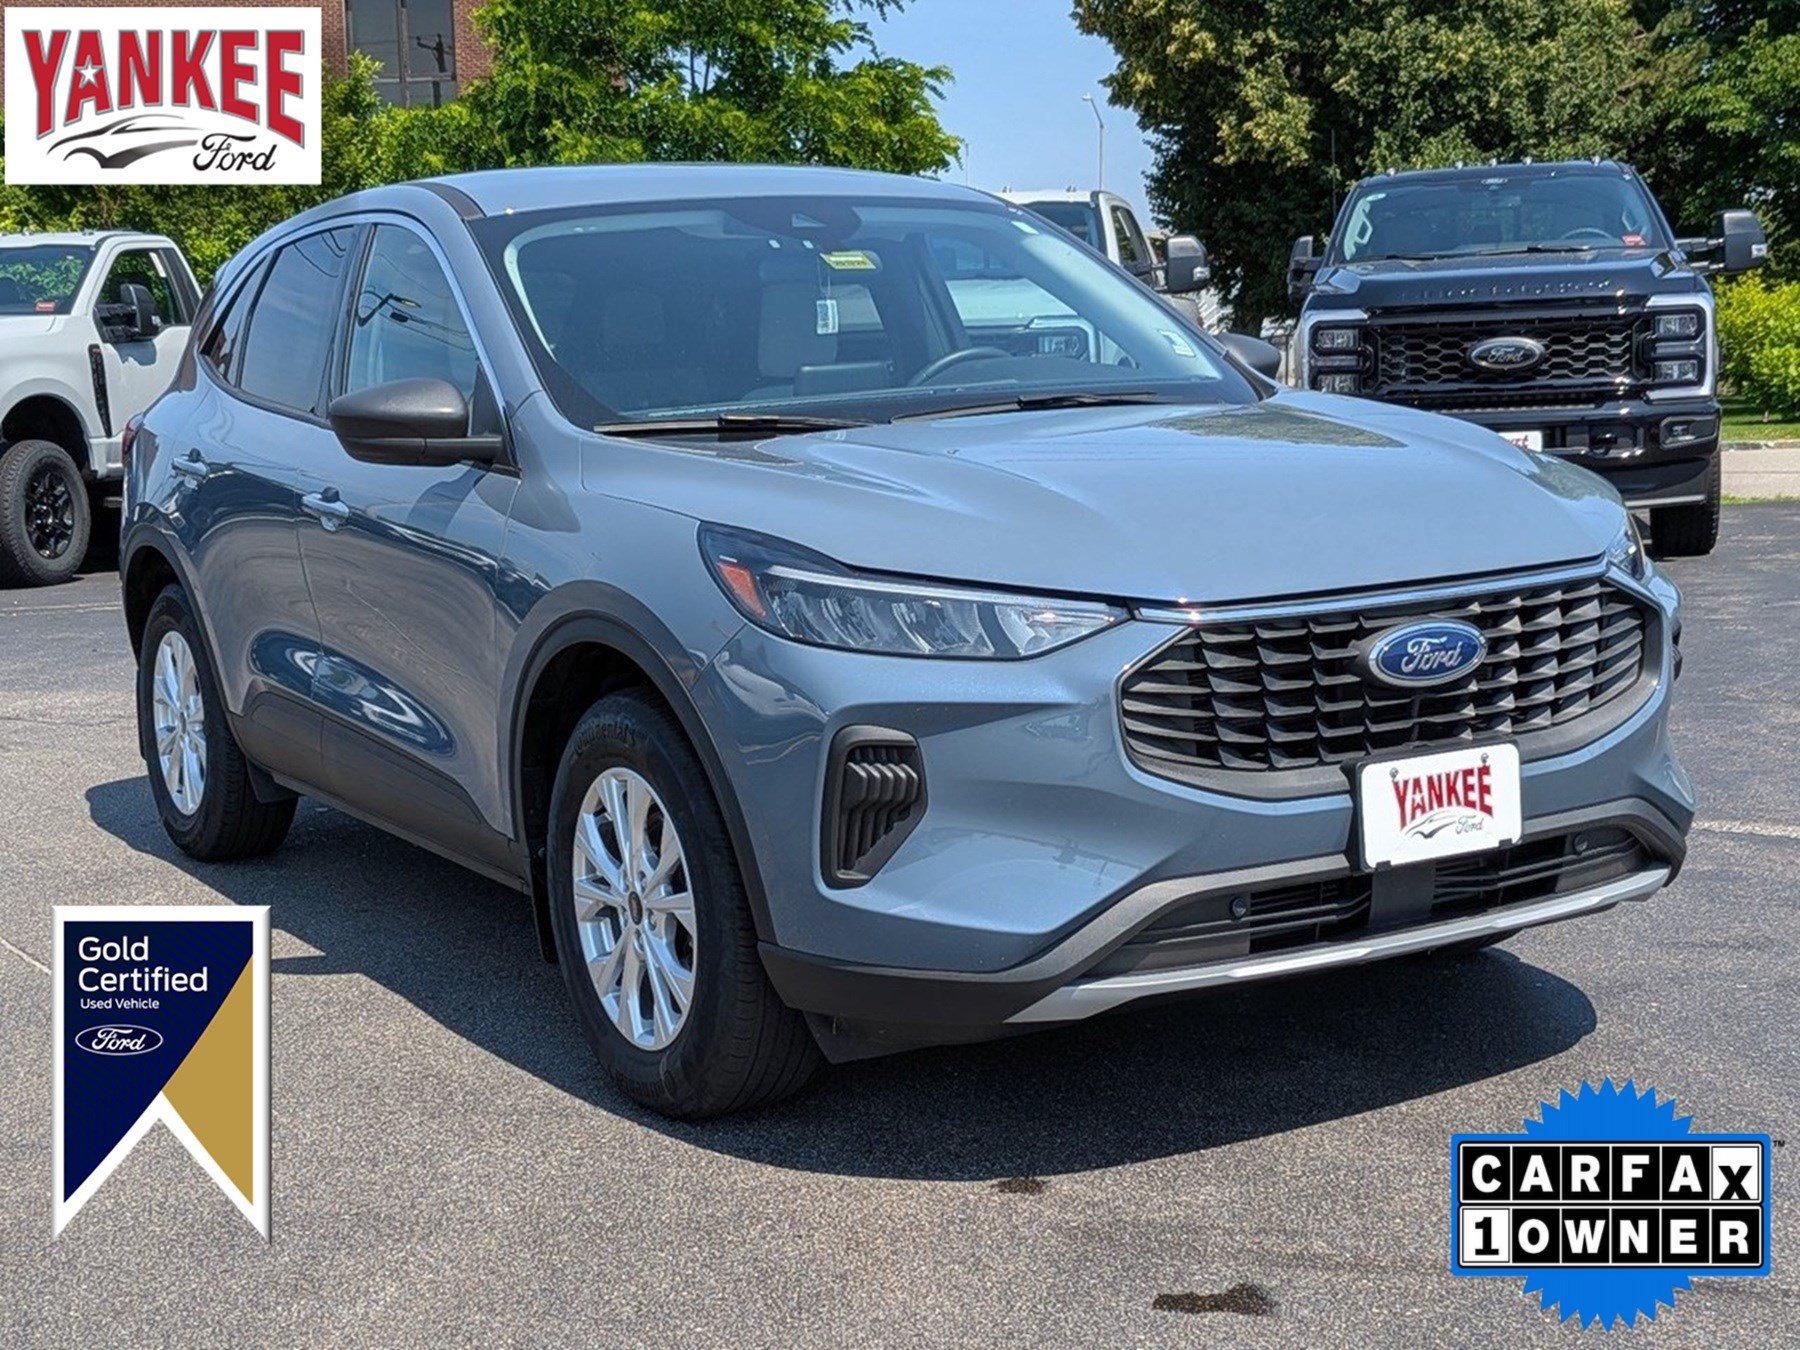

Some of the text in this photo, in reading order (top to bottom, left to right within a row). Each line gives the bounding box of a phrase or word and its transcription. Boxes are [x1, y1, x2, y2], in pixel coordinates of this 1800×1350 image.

[1488, 347, 1525, 362] Ford
[1401, 636, 1463, 673] Ford
[1392, 764, 1494, 831] YANKEE
[1455, 814, 1484, 835] Ford
